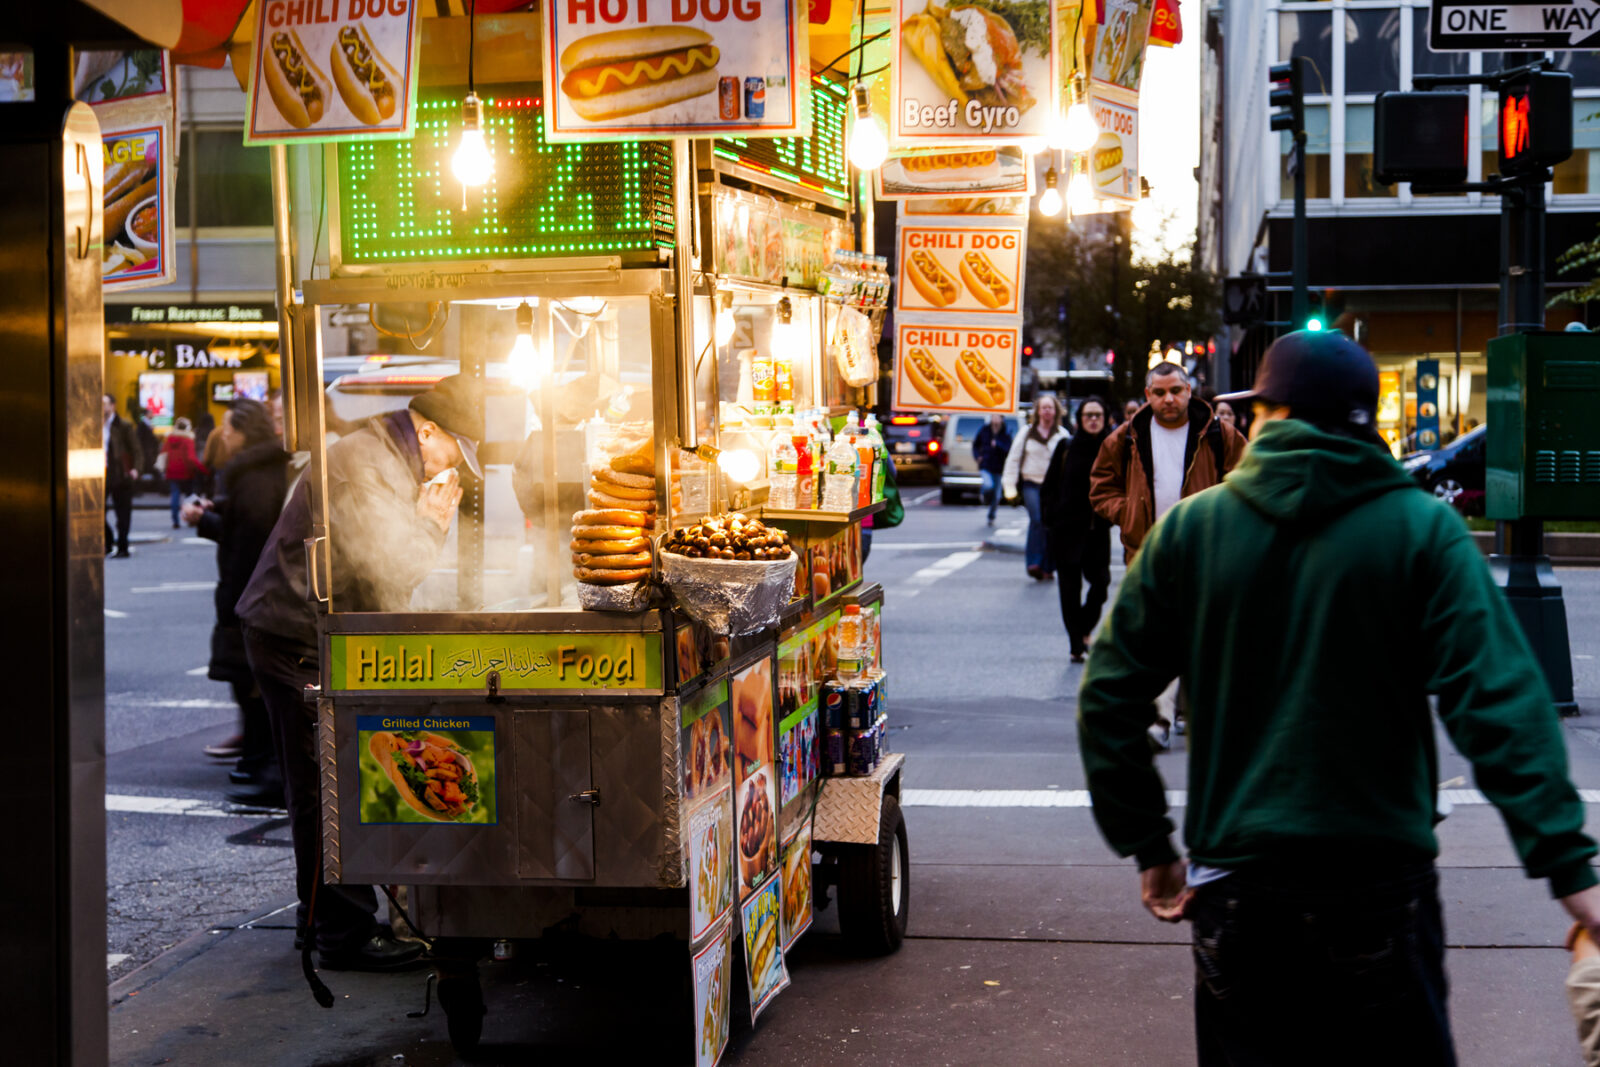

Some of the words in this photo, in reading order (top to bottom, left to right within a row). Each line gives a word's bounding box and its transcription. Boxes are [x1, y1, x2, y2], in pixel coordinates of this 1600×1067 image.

[268, 0, 340, 28] CHILI
[348, 0, 408, 19] DOG
[568, 0, 649, 25] HOT
[671, 0, 762, 23] DOG
[1447, 9, 1507, 32] ONE
[1542, 7, 1600, 31] WAY
[904, 97, 958, 129] Beef
[965, 99, 1020, 134] Gyro
[1094, 105, 1112, 129] HOT
[1114, 111, 1133, 135] DOG
[908, 232, 965, 250] CHILI
[971, 232, 1016, 250] DOG
[906, 330, 960, 348] CHILI
[969, 331, 1012, 349] DOG
[357, 643, 434, 683] Halal
[556, 643, 635, 683] Food
[382, 717, 420, 729] Grilled
[424, 717, 470, 729] Chicken
